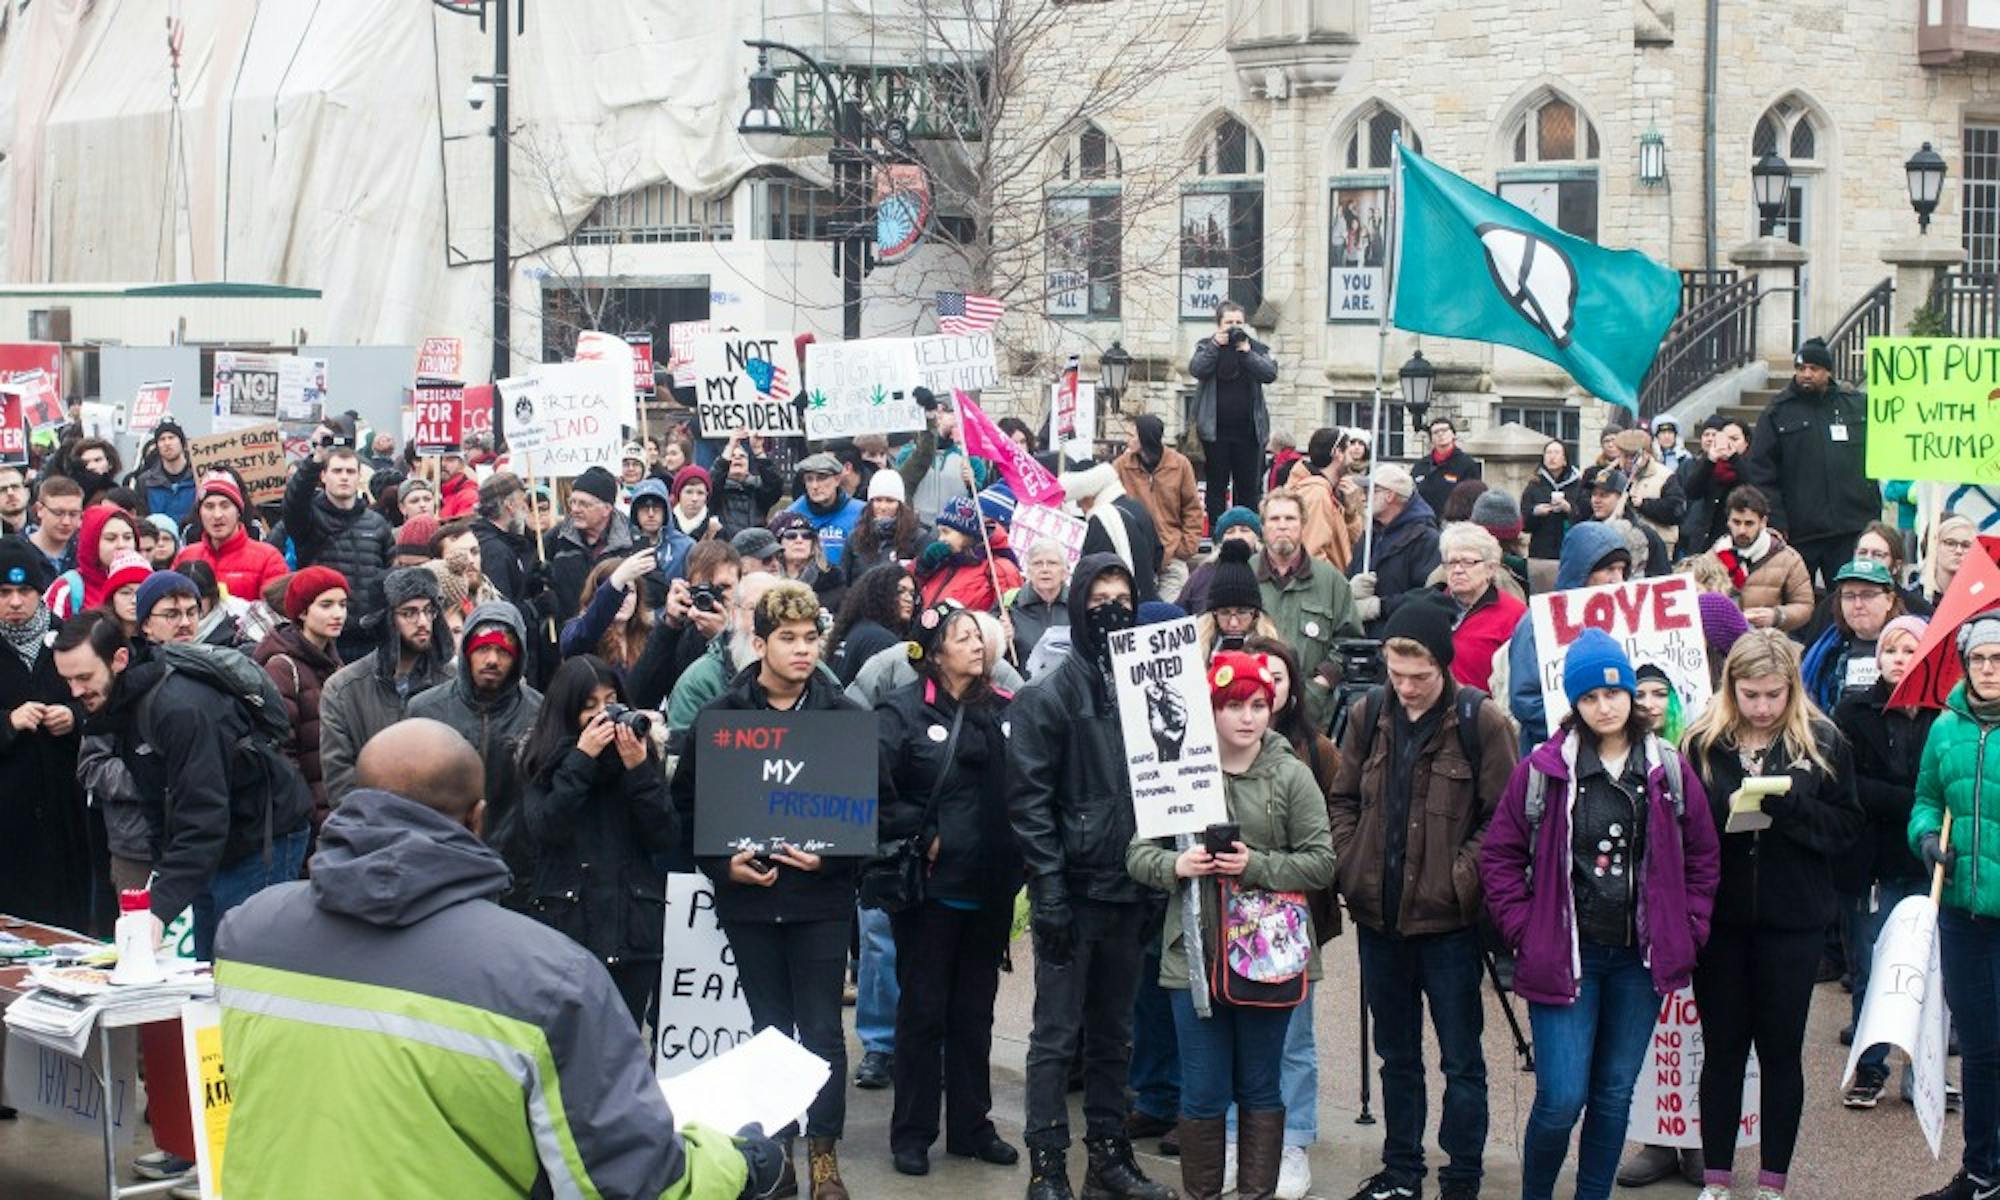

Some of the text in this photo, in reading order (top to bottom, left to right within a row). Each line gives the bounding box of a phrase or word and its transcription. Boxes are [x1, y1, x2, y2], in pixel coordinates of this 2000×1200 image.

[1049, 275, 1085, 289] BRING
[1196, 275, 1213, 290] OF
[1342, 274, 1372, 291] YOU
[1057, 294, 1078, 308] ALL
[1190, 295, 1219, 309] WHO
[1341, 295, 1375, 312] ARE.
[418, 355, 457, 372] TRUMP
[725, 340, 778, 372] NOT
[1872, 344, 2000, 386] NOT PUT
[232, 372, 277, 400] NO!
[417, 388, 463, 400] MEDICARE
[705, 376, 738, 400] MY
[417, 402, 452, 423] FOR
[700, 402, 806, 433] PRESIDENT
[1874, 396, 1976, 424] UP WITH
[191, 430, 279, 456] Support EQUITY
[417, 423, 453, 443] ALL
[1904, 432, 1995, 462] TRUMP
[1548, 578, 1692, 648] LOVE
[1111, 624, 1197, 655] WE STAND
[1130, 655, 1183, 685] UNITED
[713, 727, 790, 750] #NOT
[762, 759, 805, 785] MY
[768, 790, 876, 827] PRESIDENT
[1655, 1031, 1683, 1049] NO
[1655, 1050, 1681, 1067] NO
[1656, 1069, 1682, 1087] NO
[1656, 1092, 1683, 1113] NO
[1658, 1116, 1687, 1137] NO
